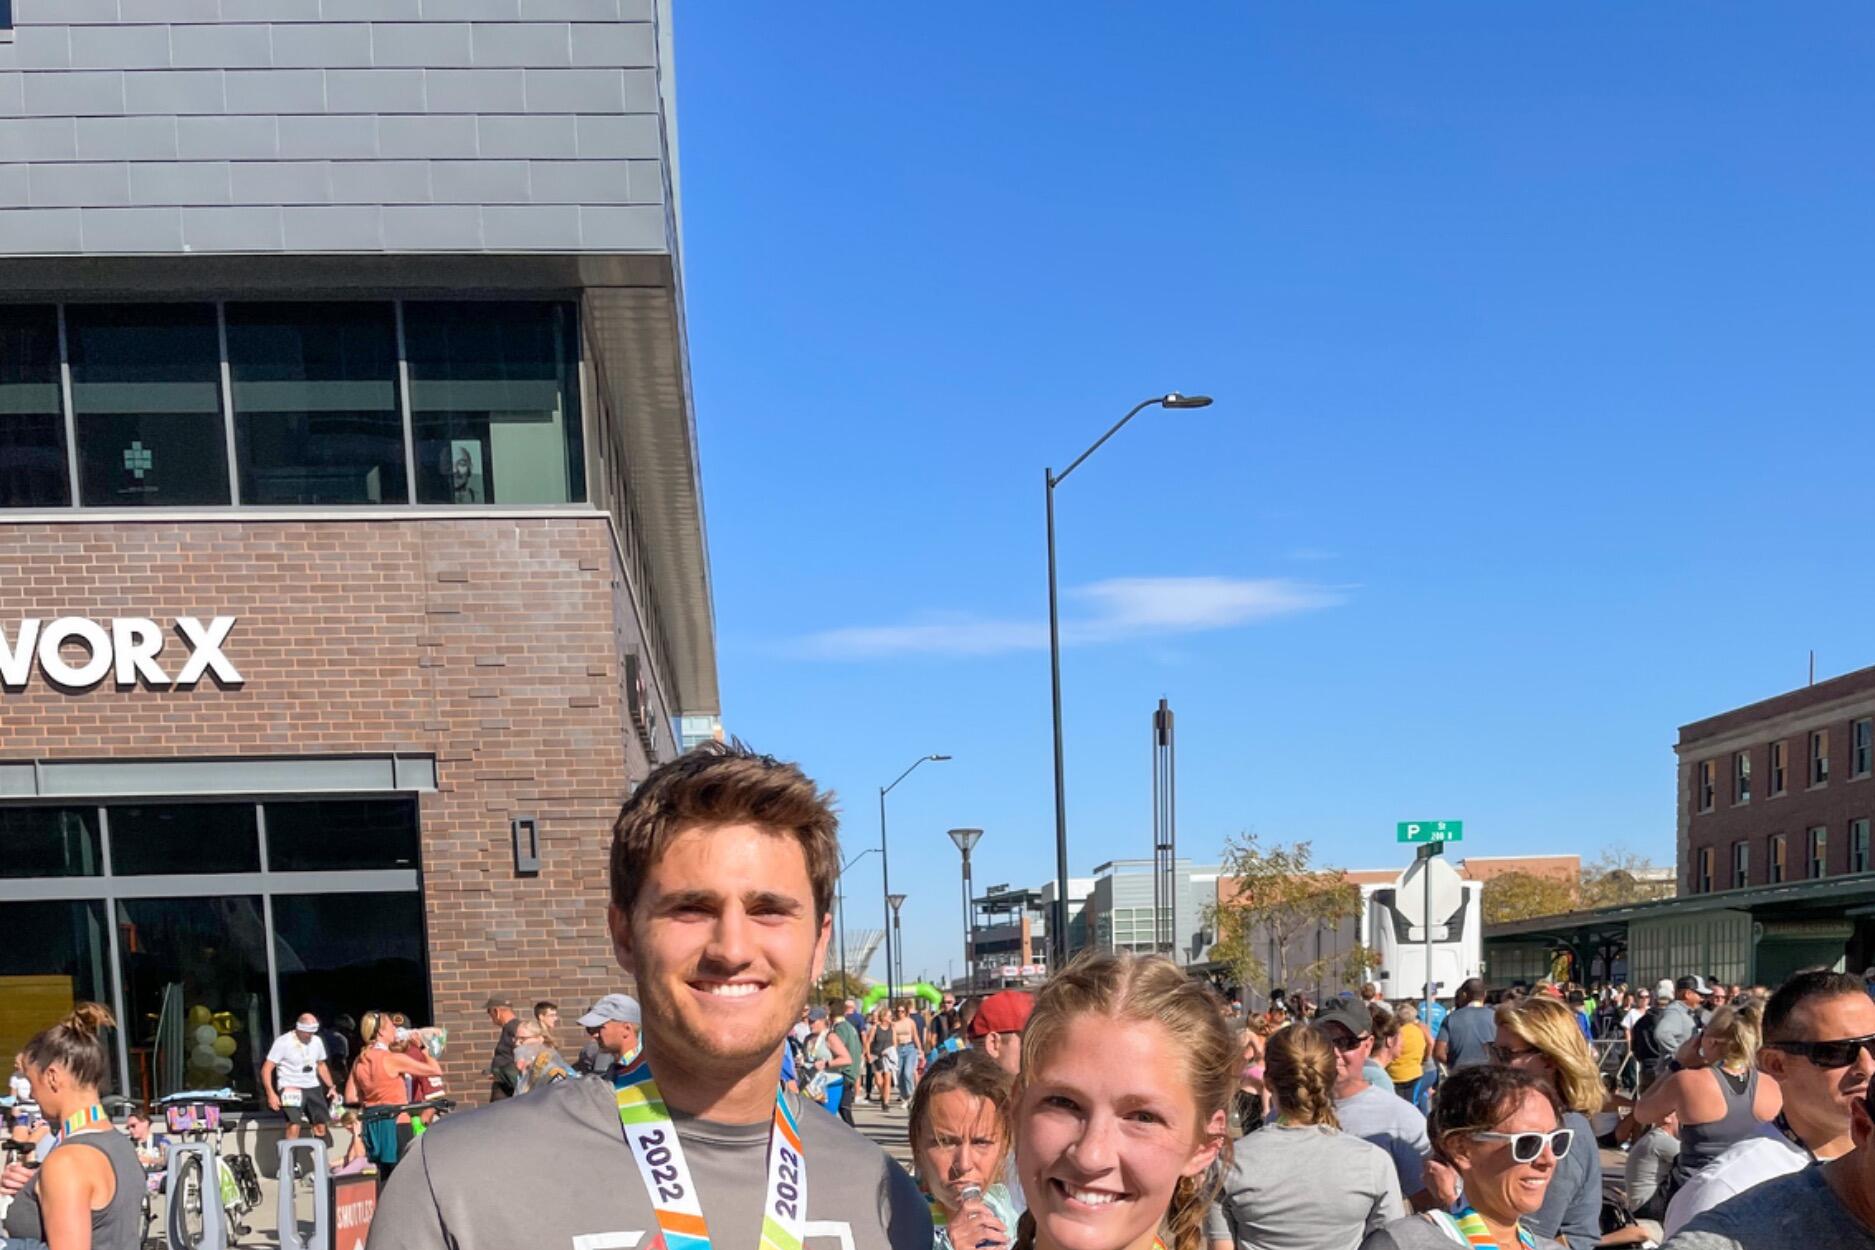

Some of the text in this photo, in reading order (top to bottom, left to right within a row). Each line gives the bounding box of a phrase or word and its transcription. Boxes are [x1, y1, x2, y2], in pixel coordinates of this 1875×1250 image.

[1407, 824, 1421, 840] P
[638, 1128, 685, 1204] 2022
[774, 1146, 799, 1221] 2022
